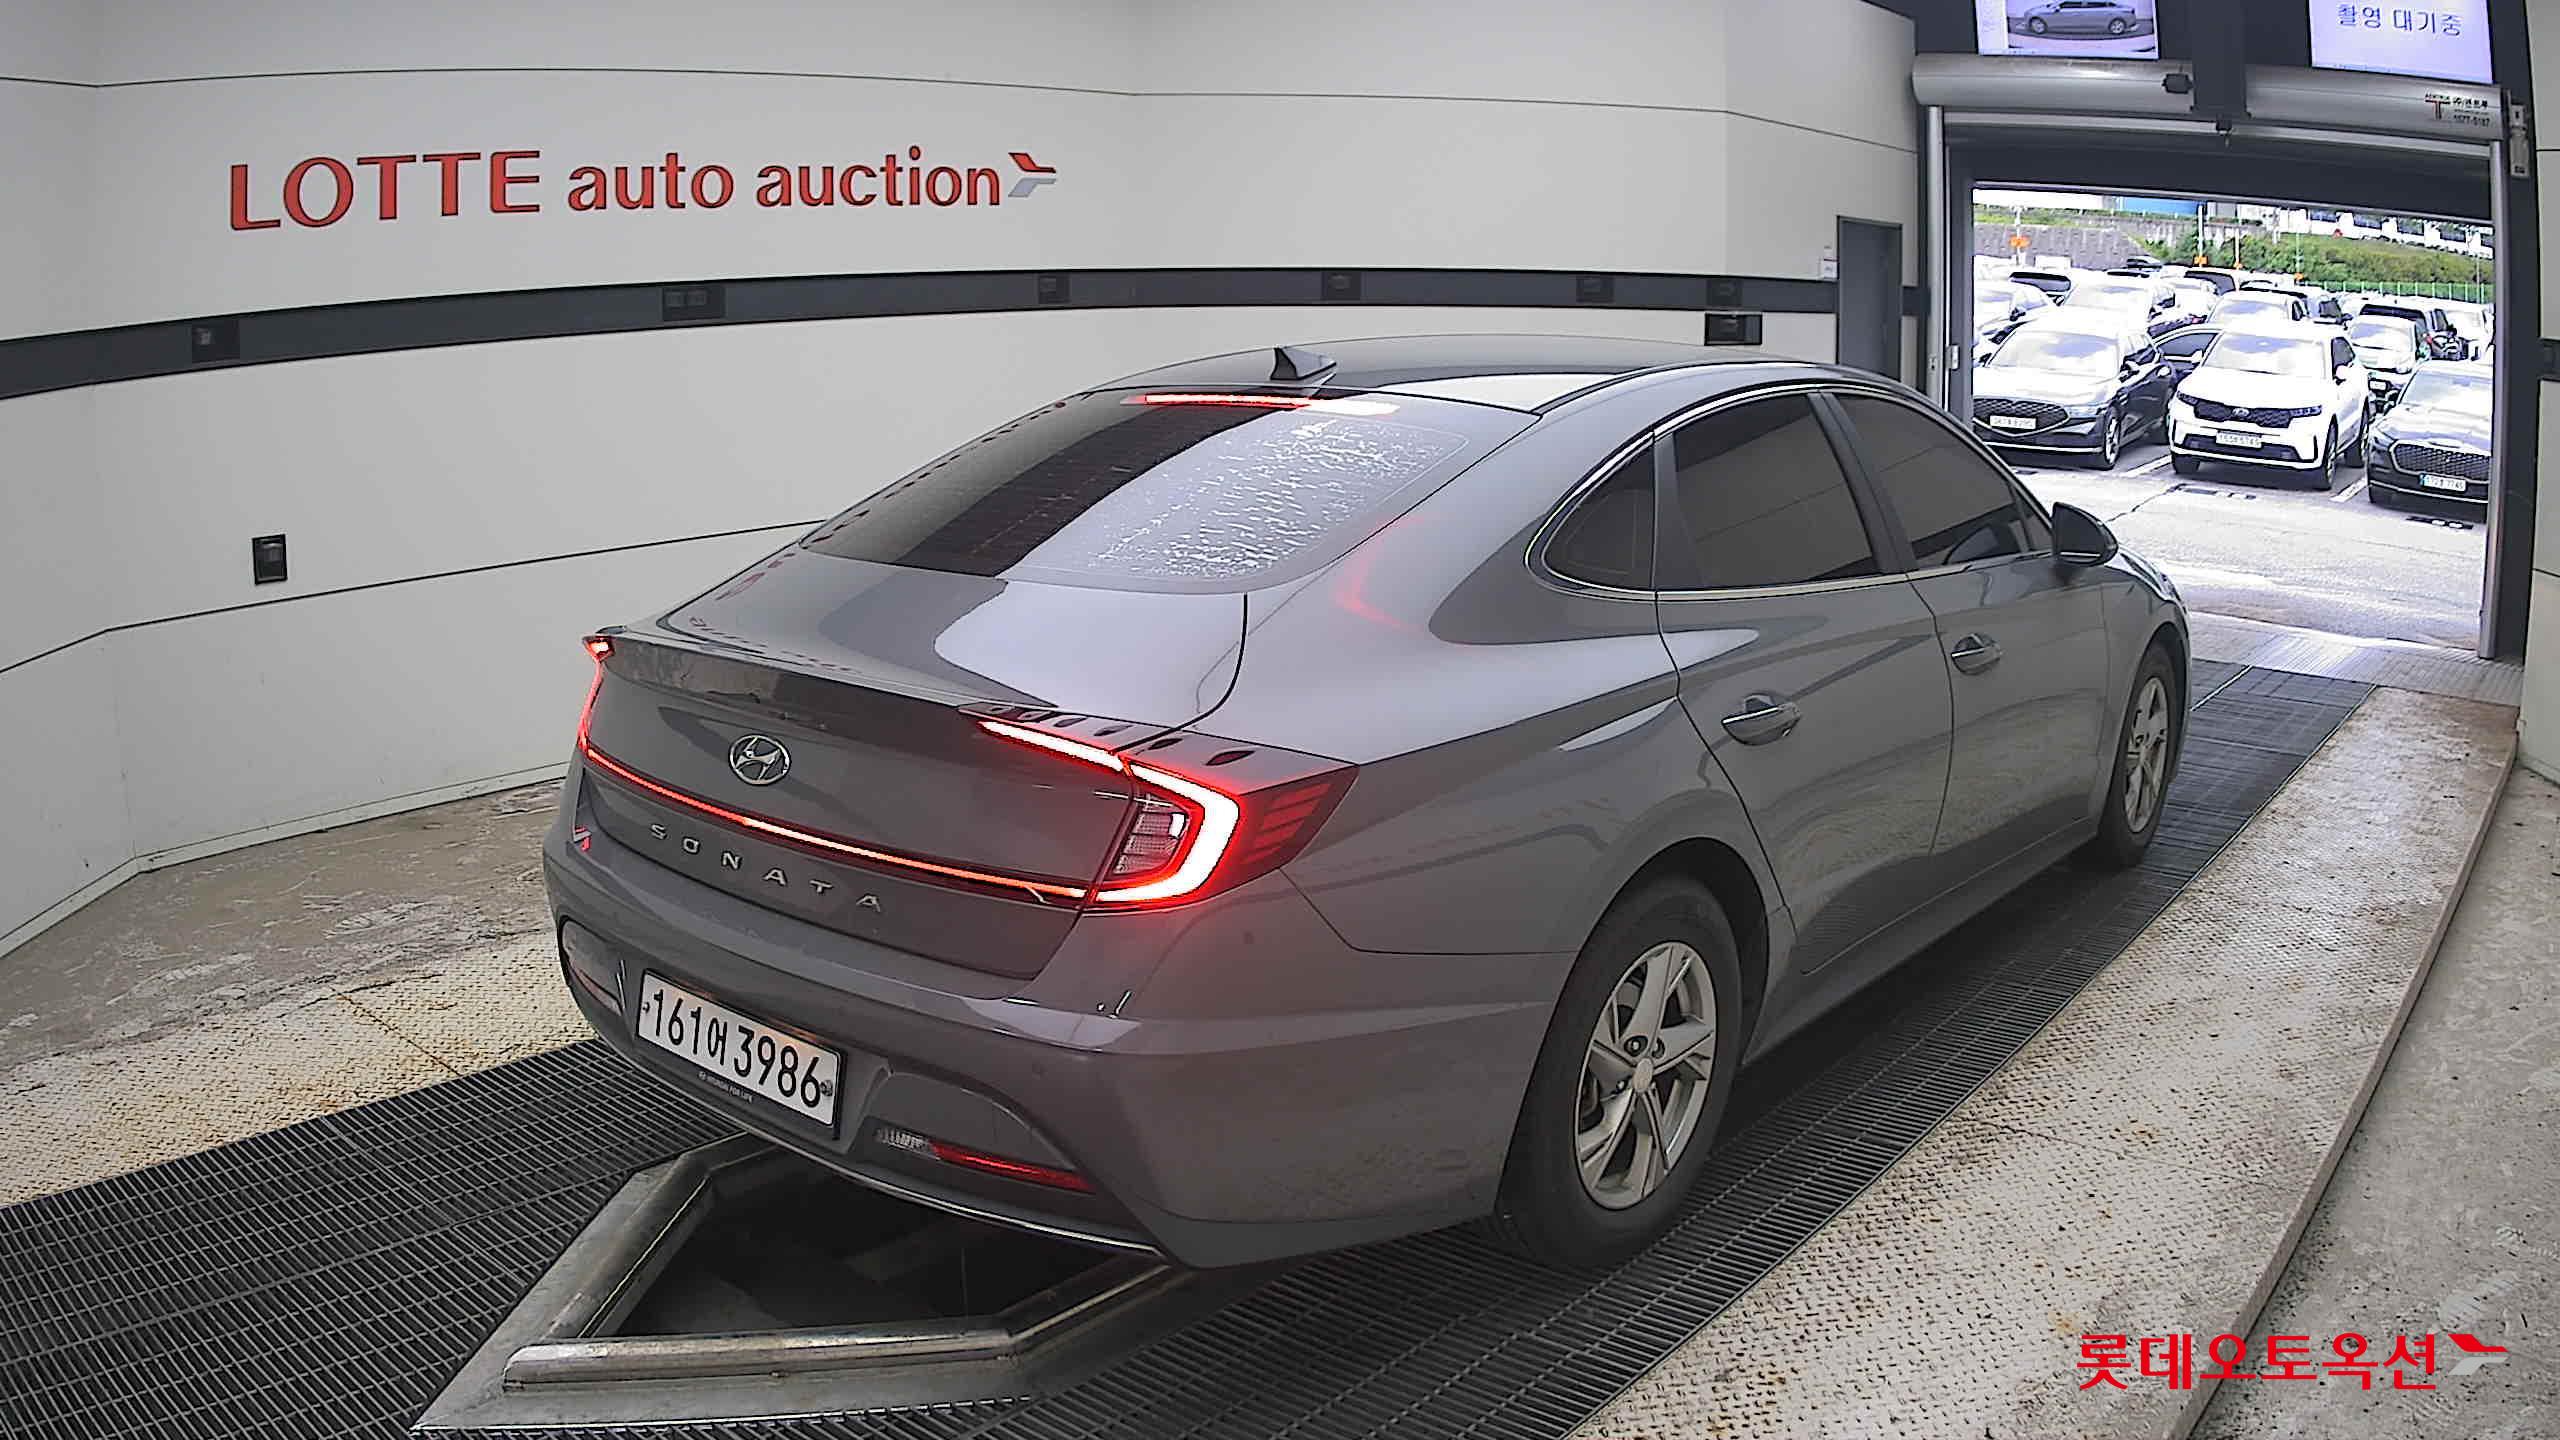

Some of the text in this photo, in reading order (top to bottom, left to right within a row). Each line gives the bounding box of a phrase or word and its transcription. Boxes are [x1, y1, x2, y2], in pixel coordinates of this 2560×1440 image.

[2338, 4, 2461, 36] 촬영 대기중
[230, 145, 1000, 231] LOTTE auto auction
[650, 823, 881, 912] SONATA
